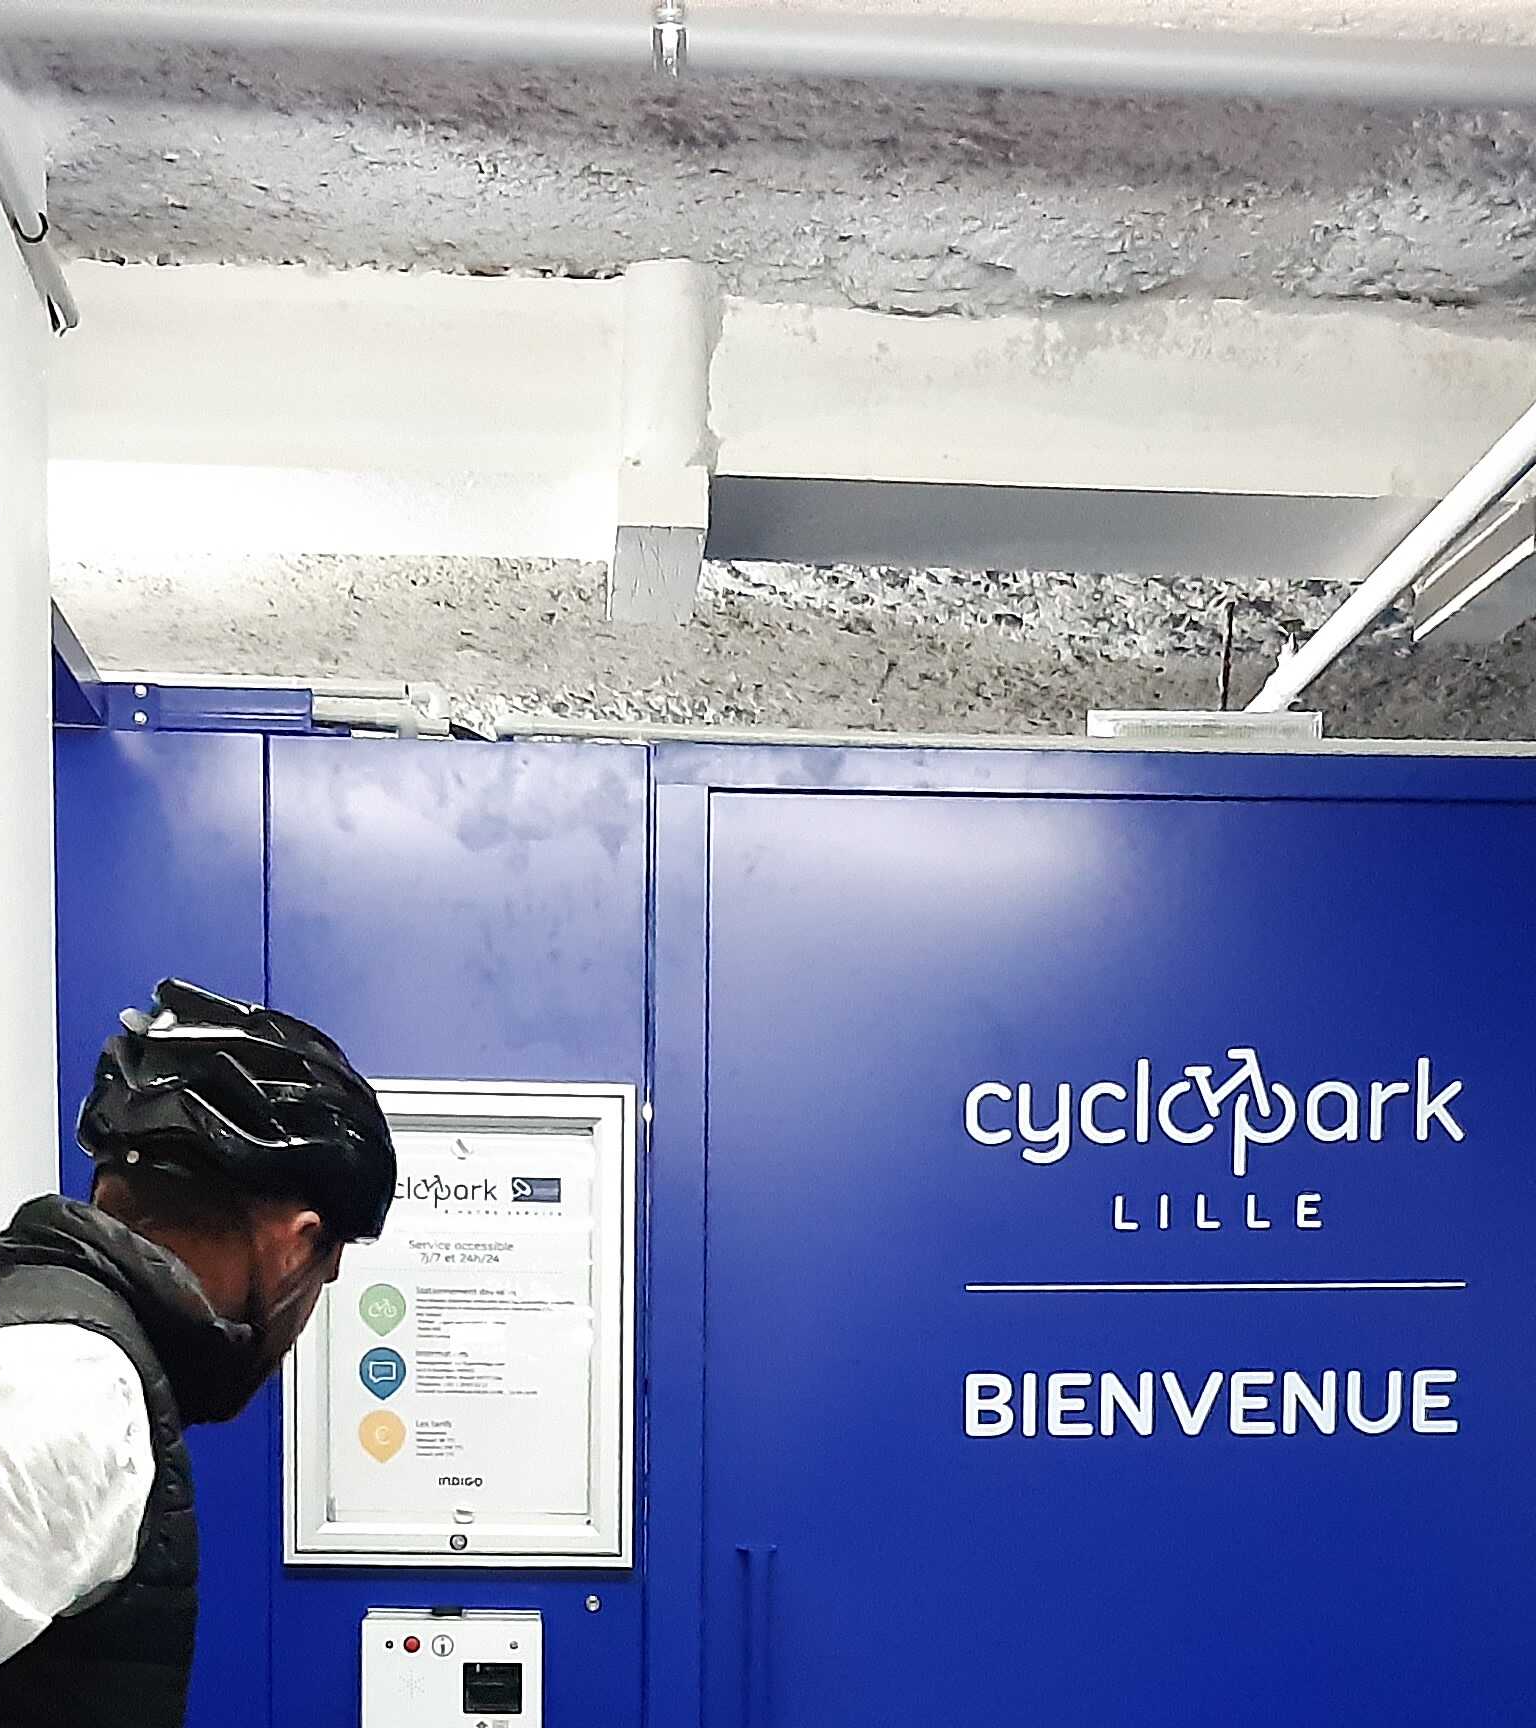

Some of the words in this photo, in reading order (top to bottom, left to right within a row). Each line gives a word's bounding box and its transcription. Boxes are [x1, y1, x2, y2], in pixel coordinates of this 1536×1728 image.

[964, 1047, 1466, 1177] cyclopark
[1112, 1192, 1323, 1231] LILLE
[409, 1239, 451, 1251] Service
[455, 1240, 515, 1252] accessible
[963, 1369, 1461, 1437] BIENVENUE
